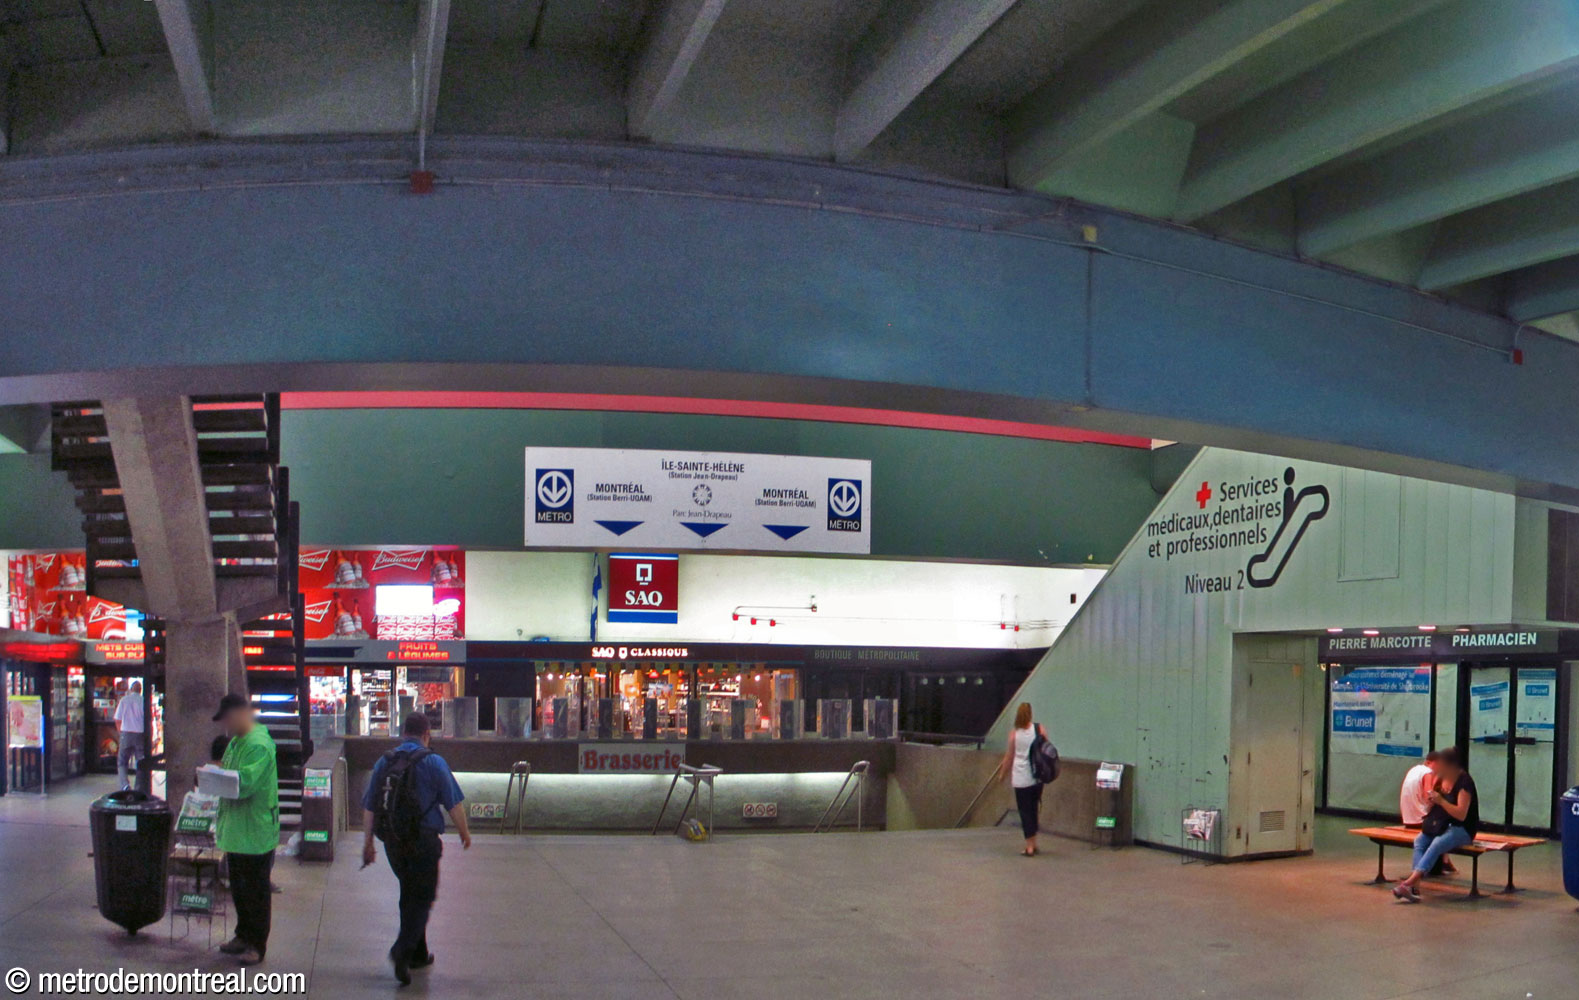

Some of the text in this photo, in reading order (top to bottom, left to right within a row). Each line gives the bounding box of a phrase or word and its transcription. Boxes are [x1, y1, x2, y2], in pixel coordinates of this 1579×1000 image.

[661, 459, 745, 473] ÎLE-SAINTE-HÉLÈNE
[668, 472, 692, 480] (Station
[595, 482, 645, 494] MONTRÉAL
[762, 487, 809, 500] MONTRÉAL
[1219, 476, 1279, 502] Services
[587, 494, 653, 503] (Station Berri-UQAM)
[754, 499, 817, 509] (Station Berri-UQAM)
[672, 509, 732, 520] Parc Jean-Drapeau
[1148, 523, 1268, 561] et professionnels
[1185, 569, 1245, 594] Niveau 2
[625, 590, 663, 607] SAQ
[399, 642, 438, 650] FRUITS
[1329, 632, 1537, 650] PIERRE MARCOTTE PHARMACIEN
[592, 647, 688, 658] SAQ CLASSIQUE
[814, 649, 852, 660] BOUTIQUE
[1345, 715, 1373, 727] Brunet
[583, 748, 681, 770] Brasserie
[182, 817, 208, 830] métro
[183, 892, 208, 906] métro
